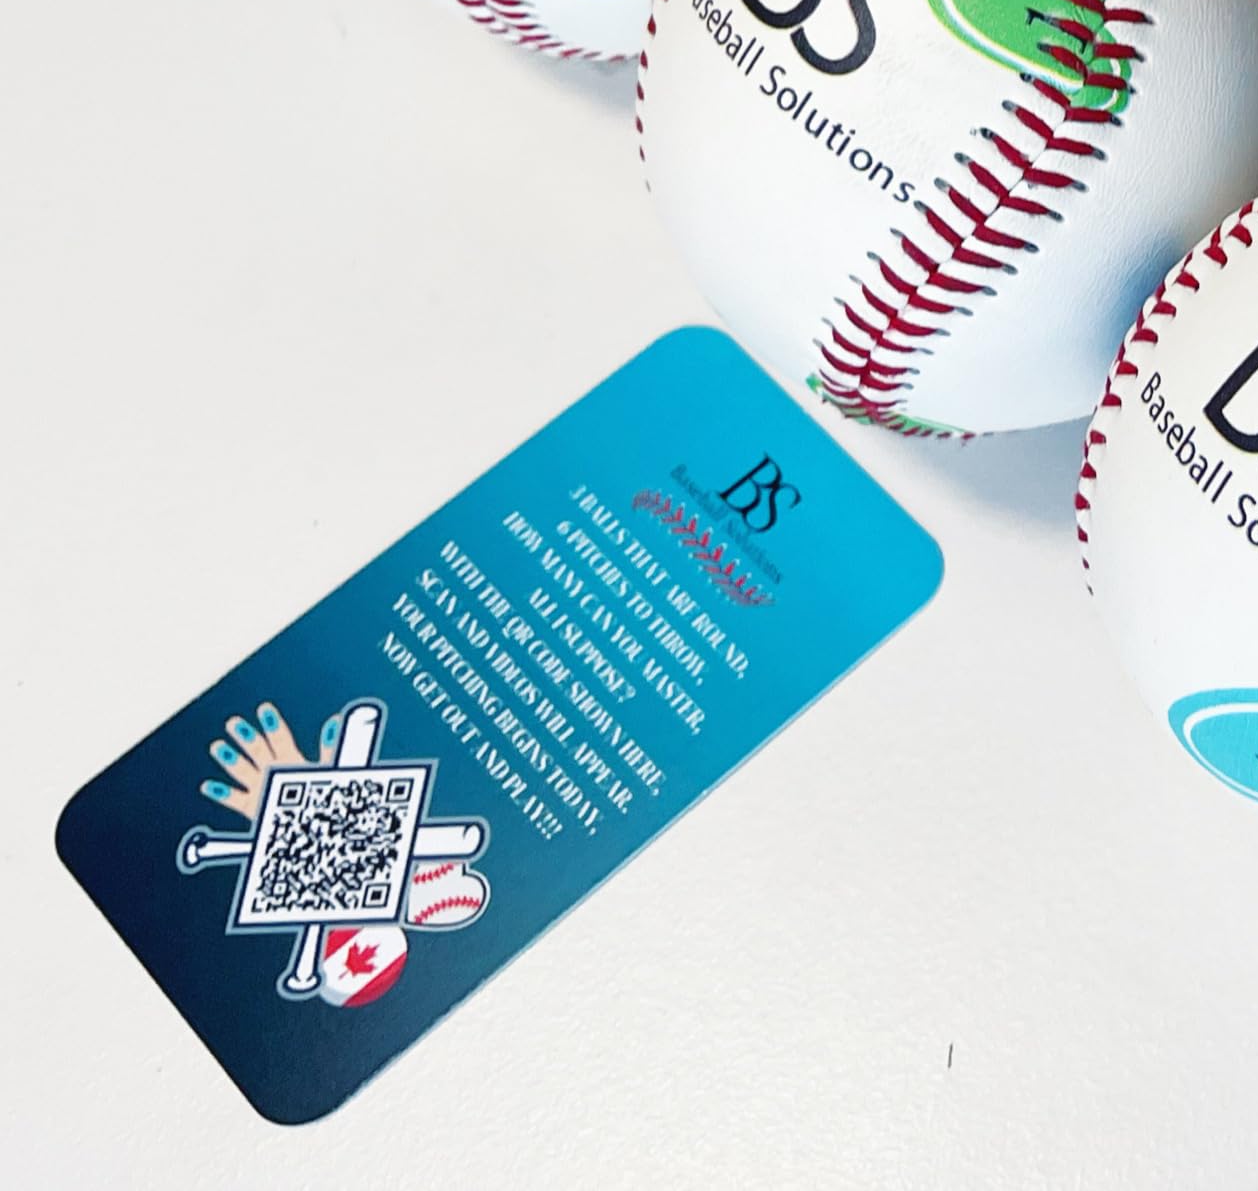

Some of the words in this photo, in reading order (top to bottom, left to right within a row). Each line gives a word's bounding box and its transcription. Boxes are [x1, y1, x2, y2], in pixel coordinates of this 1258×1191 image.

[759, 65, 915, 203] Solutions
[719, 450, 802, 533] BS
[1140, 371, 1233, 504] Baseball
[440, 540, 486, 590] WITH
[477, 584, 511, 619] THE
[501, 616, 535, 646] QR
[527, 640, 571, 686] CODE
[569, 681, 622, 746] SHOWN
[618, 739, 664, 796] HERE,
[503, 511, 543, 553] HOW
[541, 548, 584, 598] MANY
[579, 593, 613, 632] CAN
[610, 625, 643, 663] YOU
[642, 658, 705, 735] MASTER,
[529, 587, 558, 618] ALL
[561, 623, 636, 702] SUPPOSE?
[556, 520, 571, 535] 6
[567, 529, 629, 597] PITCHES
[626, 591, 654, 620] TO
[648, 615, 705, 685] THROW,
[579, 493, 626, 545] BALLS
[624, 539, 668, 585] THAT
[666, 584, 697, 616] ARE
[691, 613, 749, 679] ROUND,
[383, 632, 417, 675] NOW
[412, 671, 450, 709] GET
[441, 704, 481, 743] OUT
[475, 741, 510, 780] AND
[502, 773, 563, 840] PLAY!!!
[393, 593, 437, 643] YOUR
[429, 636, 498, 716] PITCHING
[494, 709, 552, 772] BEGINS
[546, 765, 599, 835] TODAY,
[416, 569, 457, 616] SCAN
[457, 612, 490, 648] AND
[485, 643, 541, 705] VIDEOS
[534, 698, 575, 747] WILL
[574, 742, 633, 814] APPEAR.
